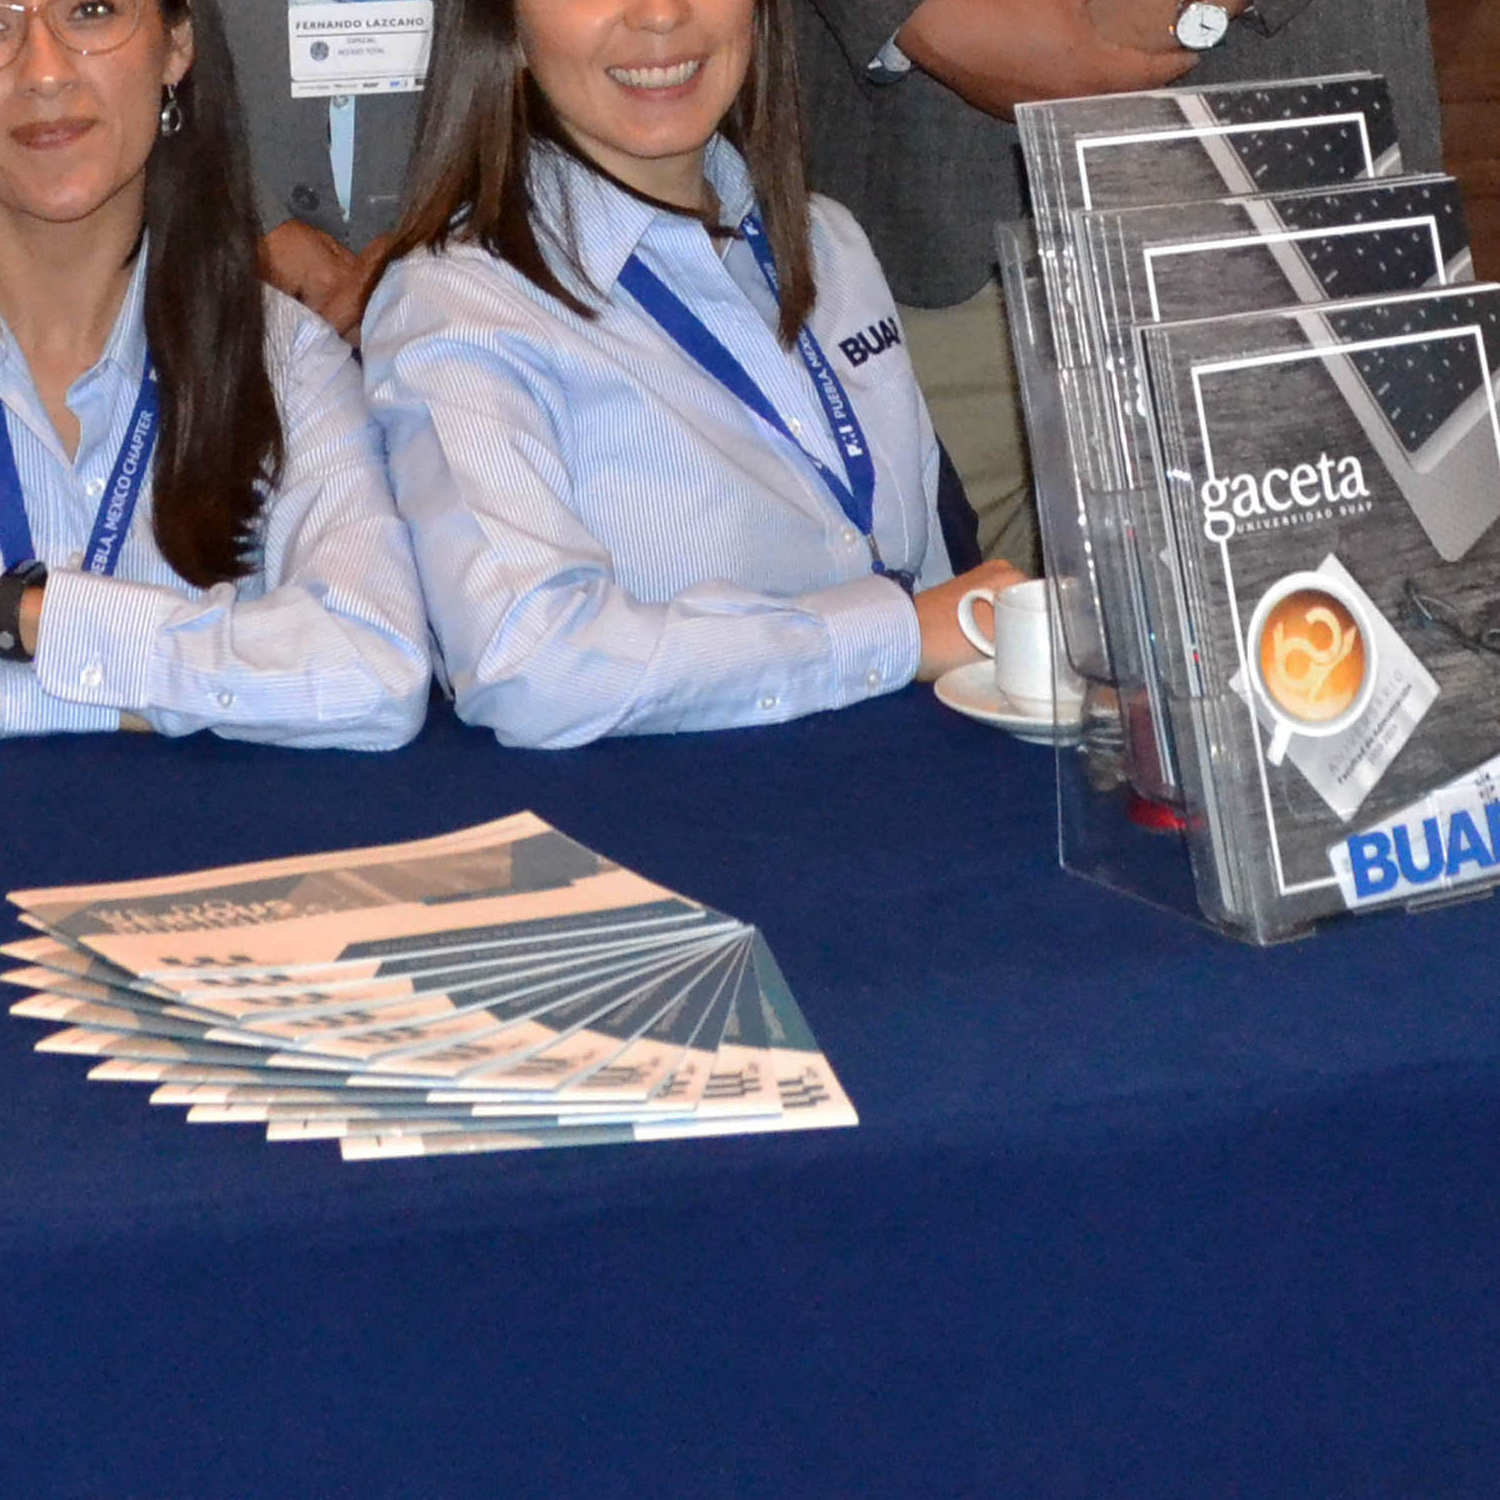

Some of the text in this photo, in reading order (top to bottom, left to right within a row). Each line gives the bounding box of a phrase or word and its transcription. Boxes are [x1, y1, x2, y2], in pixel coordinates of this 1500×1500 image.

[296, 17, 425, 30] FERNANDO LAZCANO
[838, 316, 901, 368] BUA
[91, 409, 153, 575] EBLA, MEXICO CHAPTER
[1201, 451, 1371, 543] gaceta
[1235, 507, 1334, 534] UNIVERSIDAD
